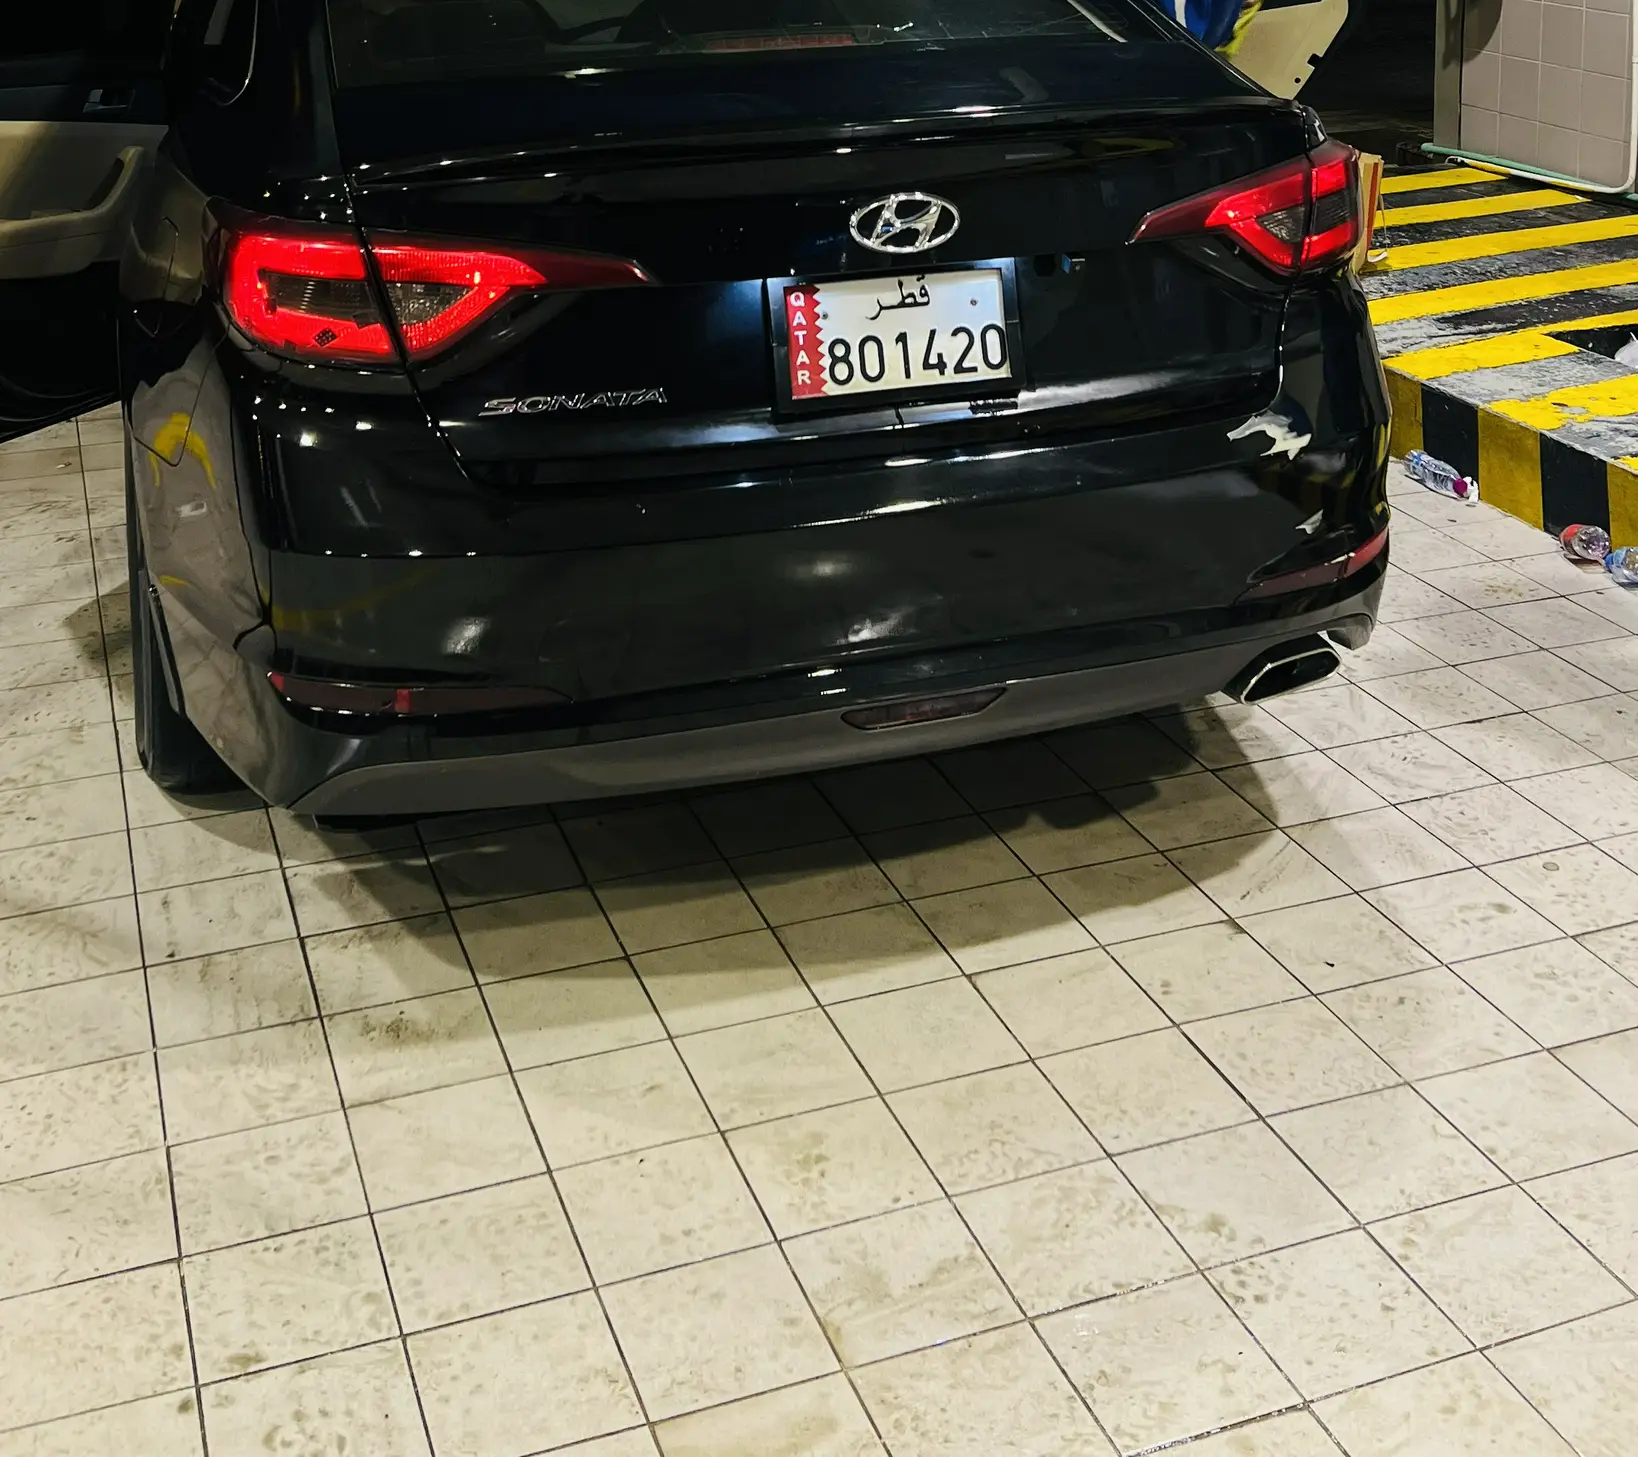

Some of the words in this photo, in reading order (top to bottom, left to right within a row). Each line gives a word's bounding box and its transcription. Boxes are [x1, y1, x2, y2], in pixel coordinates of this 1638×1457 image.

[865, 274, 931, 320] قطر
[790, 292, 811, 385] QATAR
[828, 324, 1007, 386] 801420
[478, 388, 668, 416] SONATA
